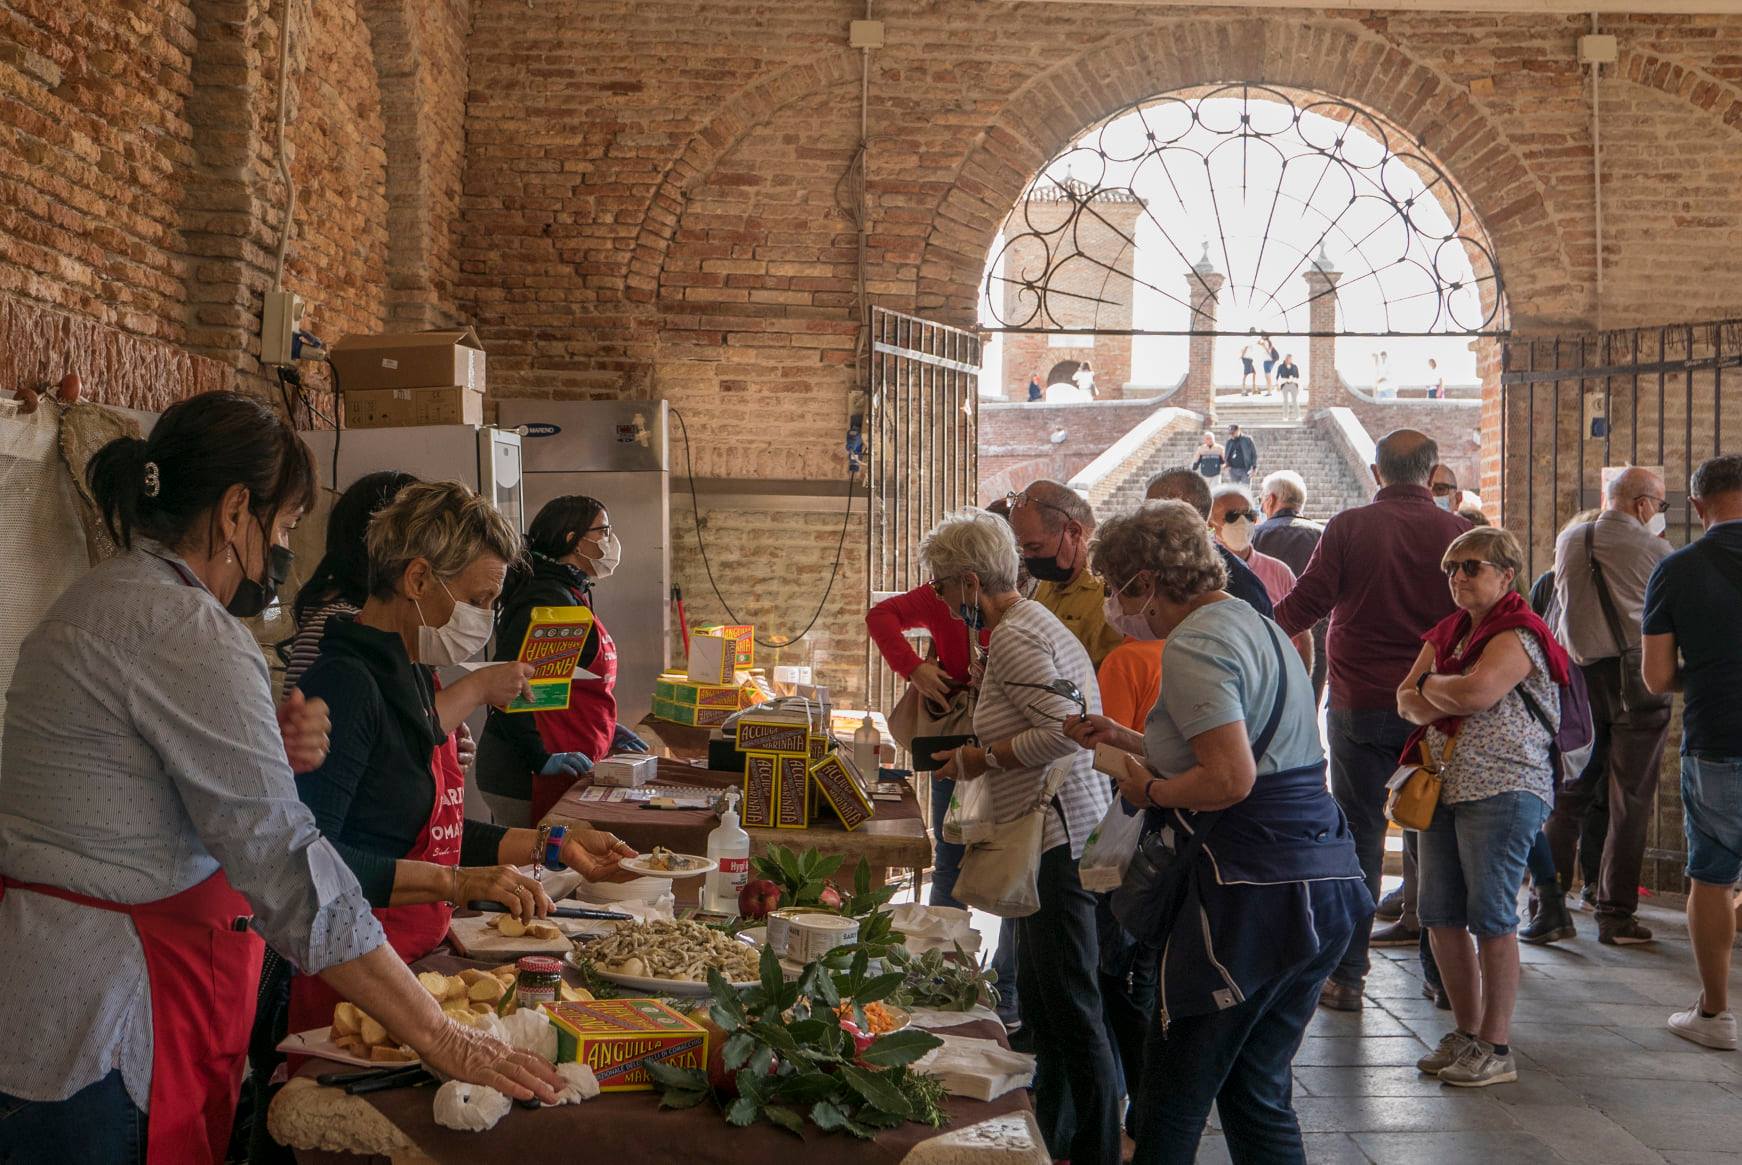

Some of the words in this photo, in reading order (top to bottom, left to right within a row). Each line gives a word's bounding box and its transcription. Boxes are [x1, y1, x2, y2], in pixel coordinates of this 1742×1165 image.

[526, 641, 580, 661] MARINATA
[534, 657, 575, 678] ANGUI
[742, 726, 778, 741] ACCIUGA
[762, 735, 804, 751] MARINATA
[440, 787, 464, 806] ARI
[747, 780, 763, 822] MARINATA
[782, 780, 798, 823] MARINATA
[829, 789, 862, 825] MARINATA
[588, 1040, 661, 1071] ANGUILLA
